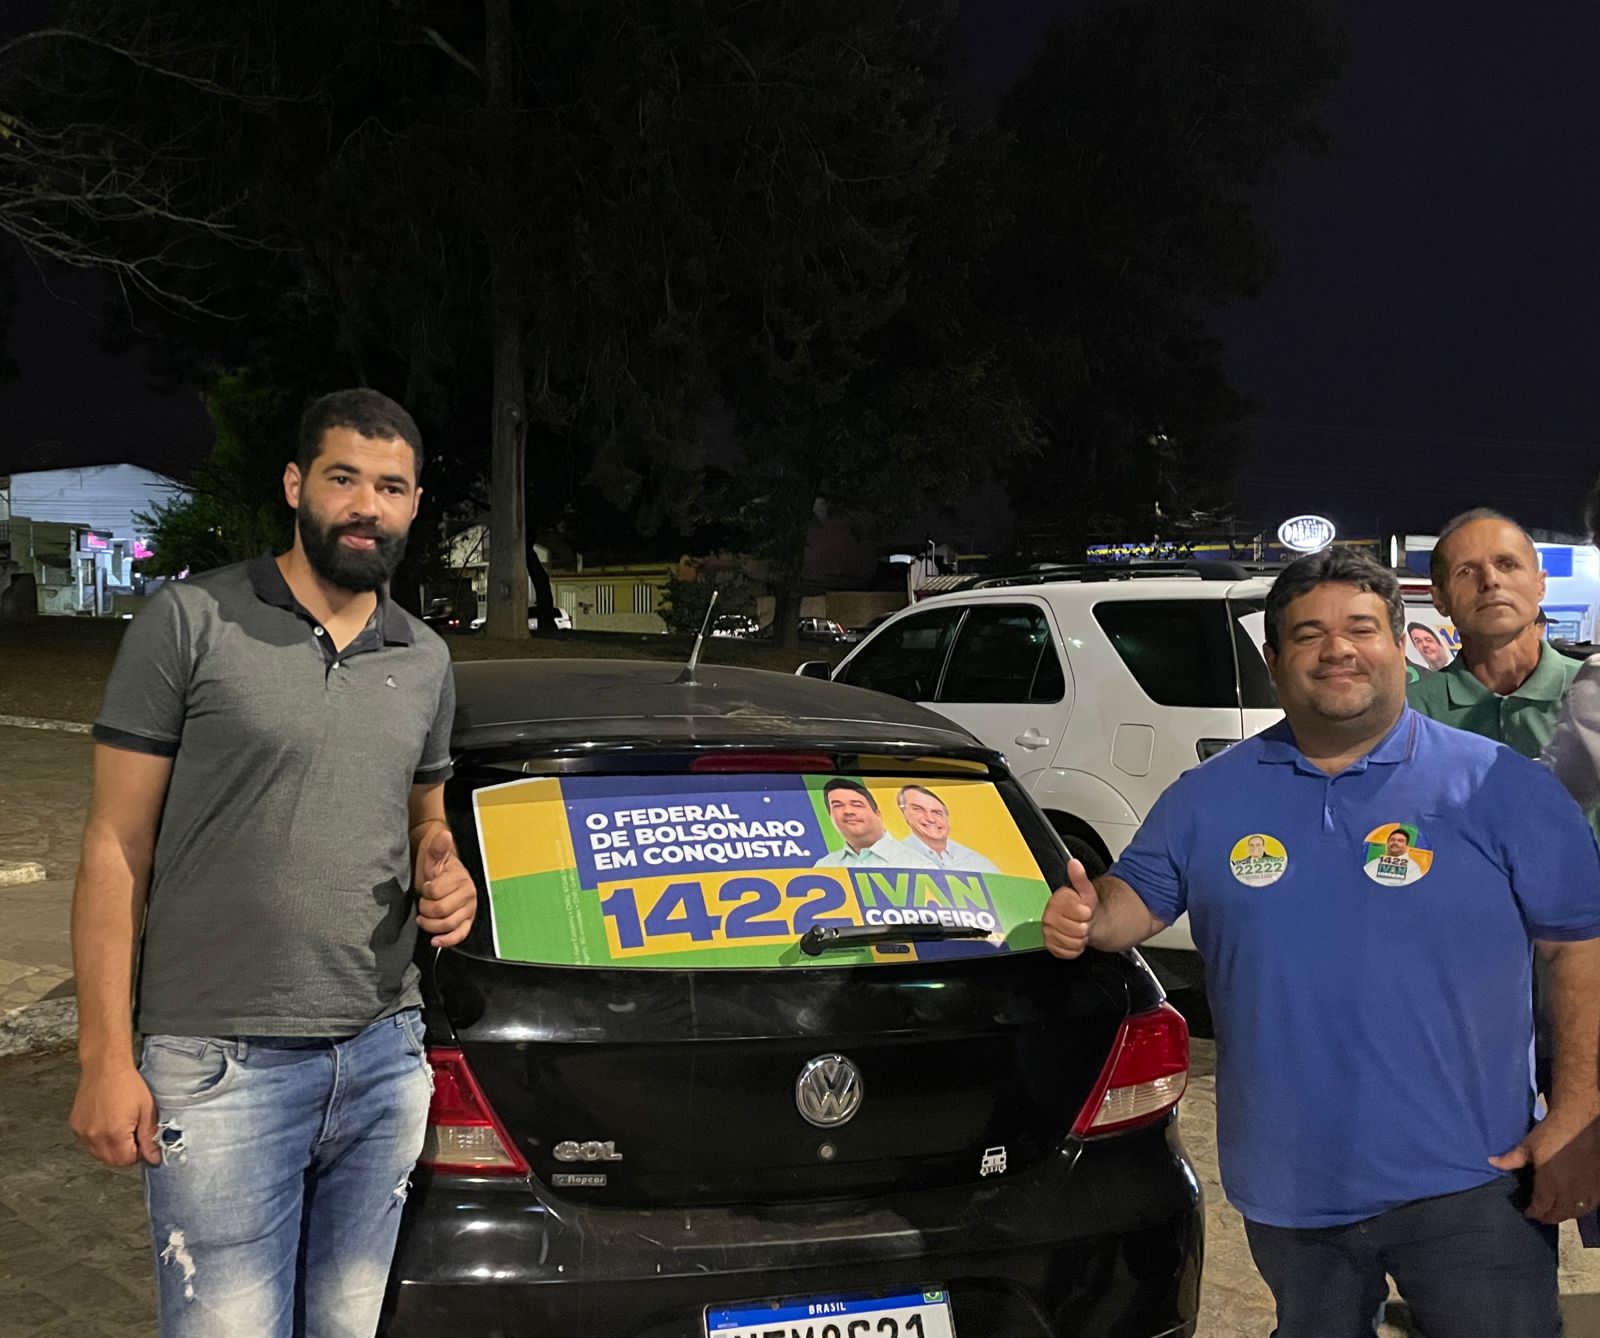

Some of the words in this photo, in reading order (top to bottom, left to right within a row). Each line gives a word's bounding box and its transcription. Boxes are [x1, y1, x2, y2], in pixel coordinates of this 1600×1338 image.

[586, 812, 609, 830] O
[614, 803, 740, 828] FEDERAL
[589, 830, 630, 851] DE
[634, 819, 806, 846] BOLSONARO
[594, 849, 638, 871] EM
[642, 839, 811, 865] CONQUISTA.
[1380, 856, 1409, 867] 1422
[1235, 862, 1283, 876] 22222
[854, 872, 990, 910] IVAN
[601, 874, 855, 950] 1422
[865, 908, 996, 930] CORDEIRO
[553, 1140, 623, 1162] GOL
[808, 1302, 847, 1316] BRASIL
